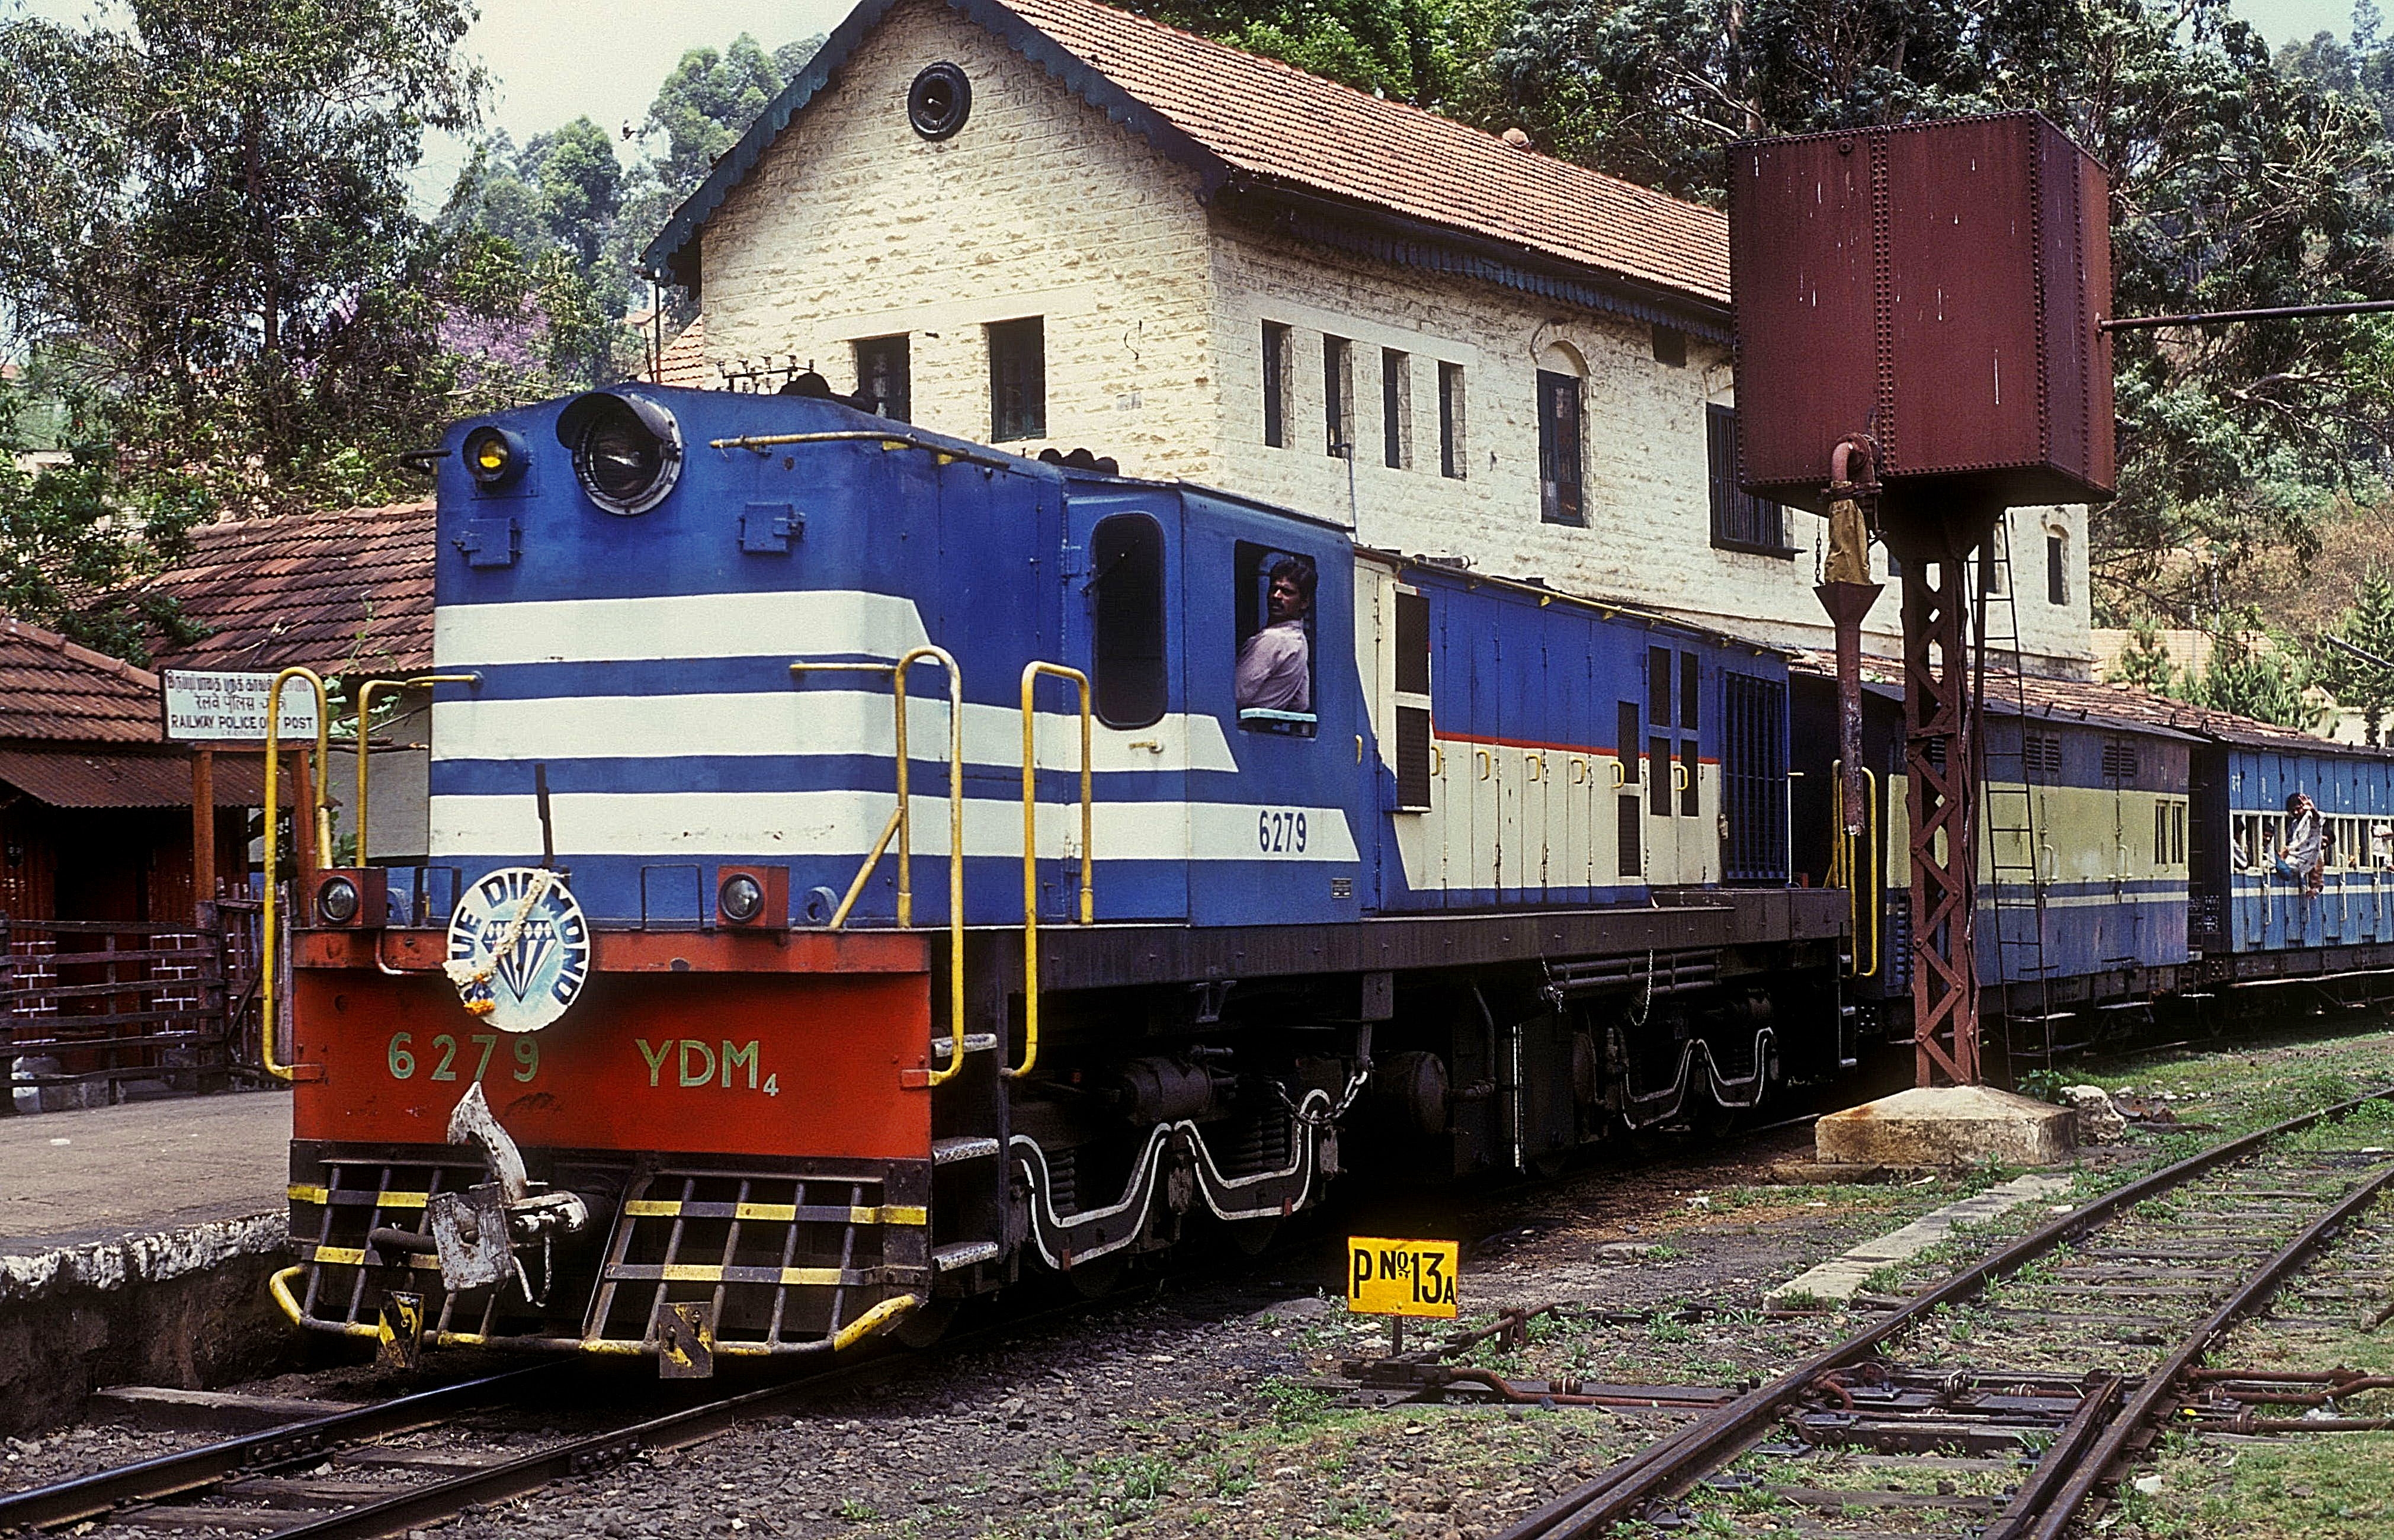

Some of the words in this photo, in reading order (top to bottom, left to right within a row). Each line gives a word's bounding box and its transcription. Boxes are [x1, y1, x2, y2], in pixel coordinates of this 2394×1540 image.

[194, 692, 220, 710] रेलवे
[224, 694, 255, 713] पुलिस
[171, 714, 214, 729] RAILWAY
[219, 716, 257, 729] POLICE
[284, 717, 313, 730] POST
[1259, 810, 1307, 854] 6279
[387, 1031, 540, 1083] 6279
